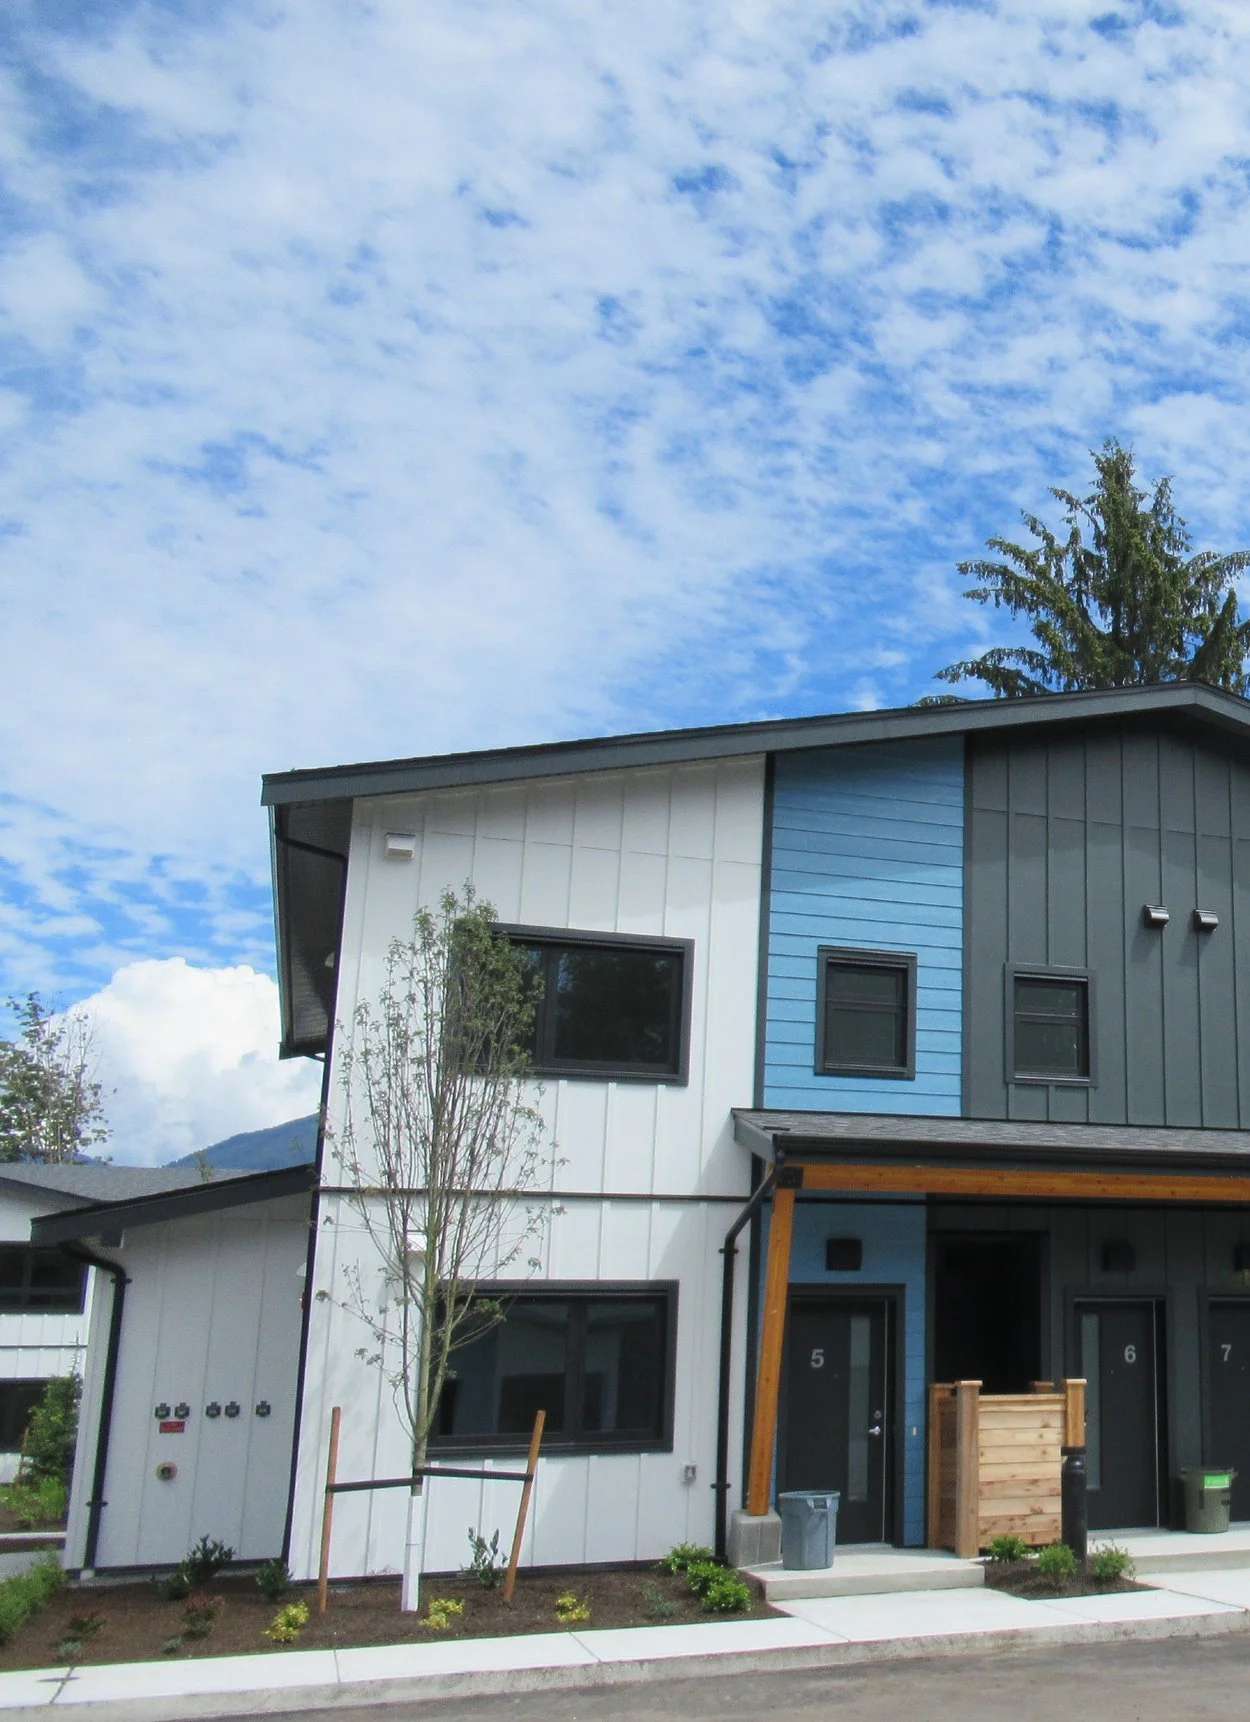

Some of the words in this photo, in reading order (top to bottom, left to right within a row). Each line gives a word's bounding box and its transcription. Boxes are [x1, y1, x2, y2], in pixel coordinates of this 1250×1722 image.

[810, 1348, 825, 1369] 5
[1124, 1344, 1137, 1363] 6
[1221, 1343, 1232, 1362] 7
